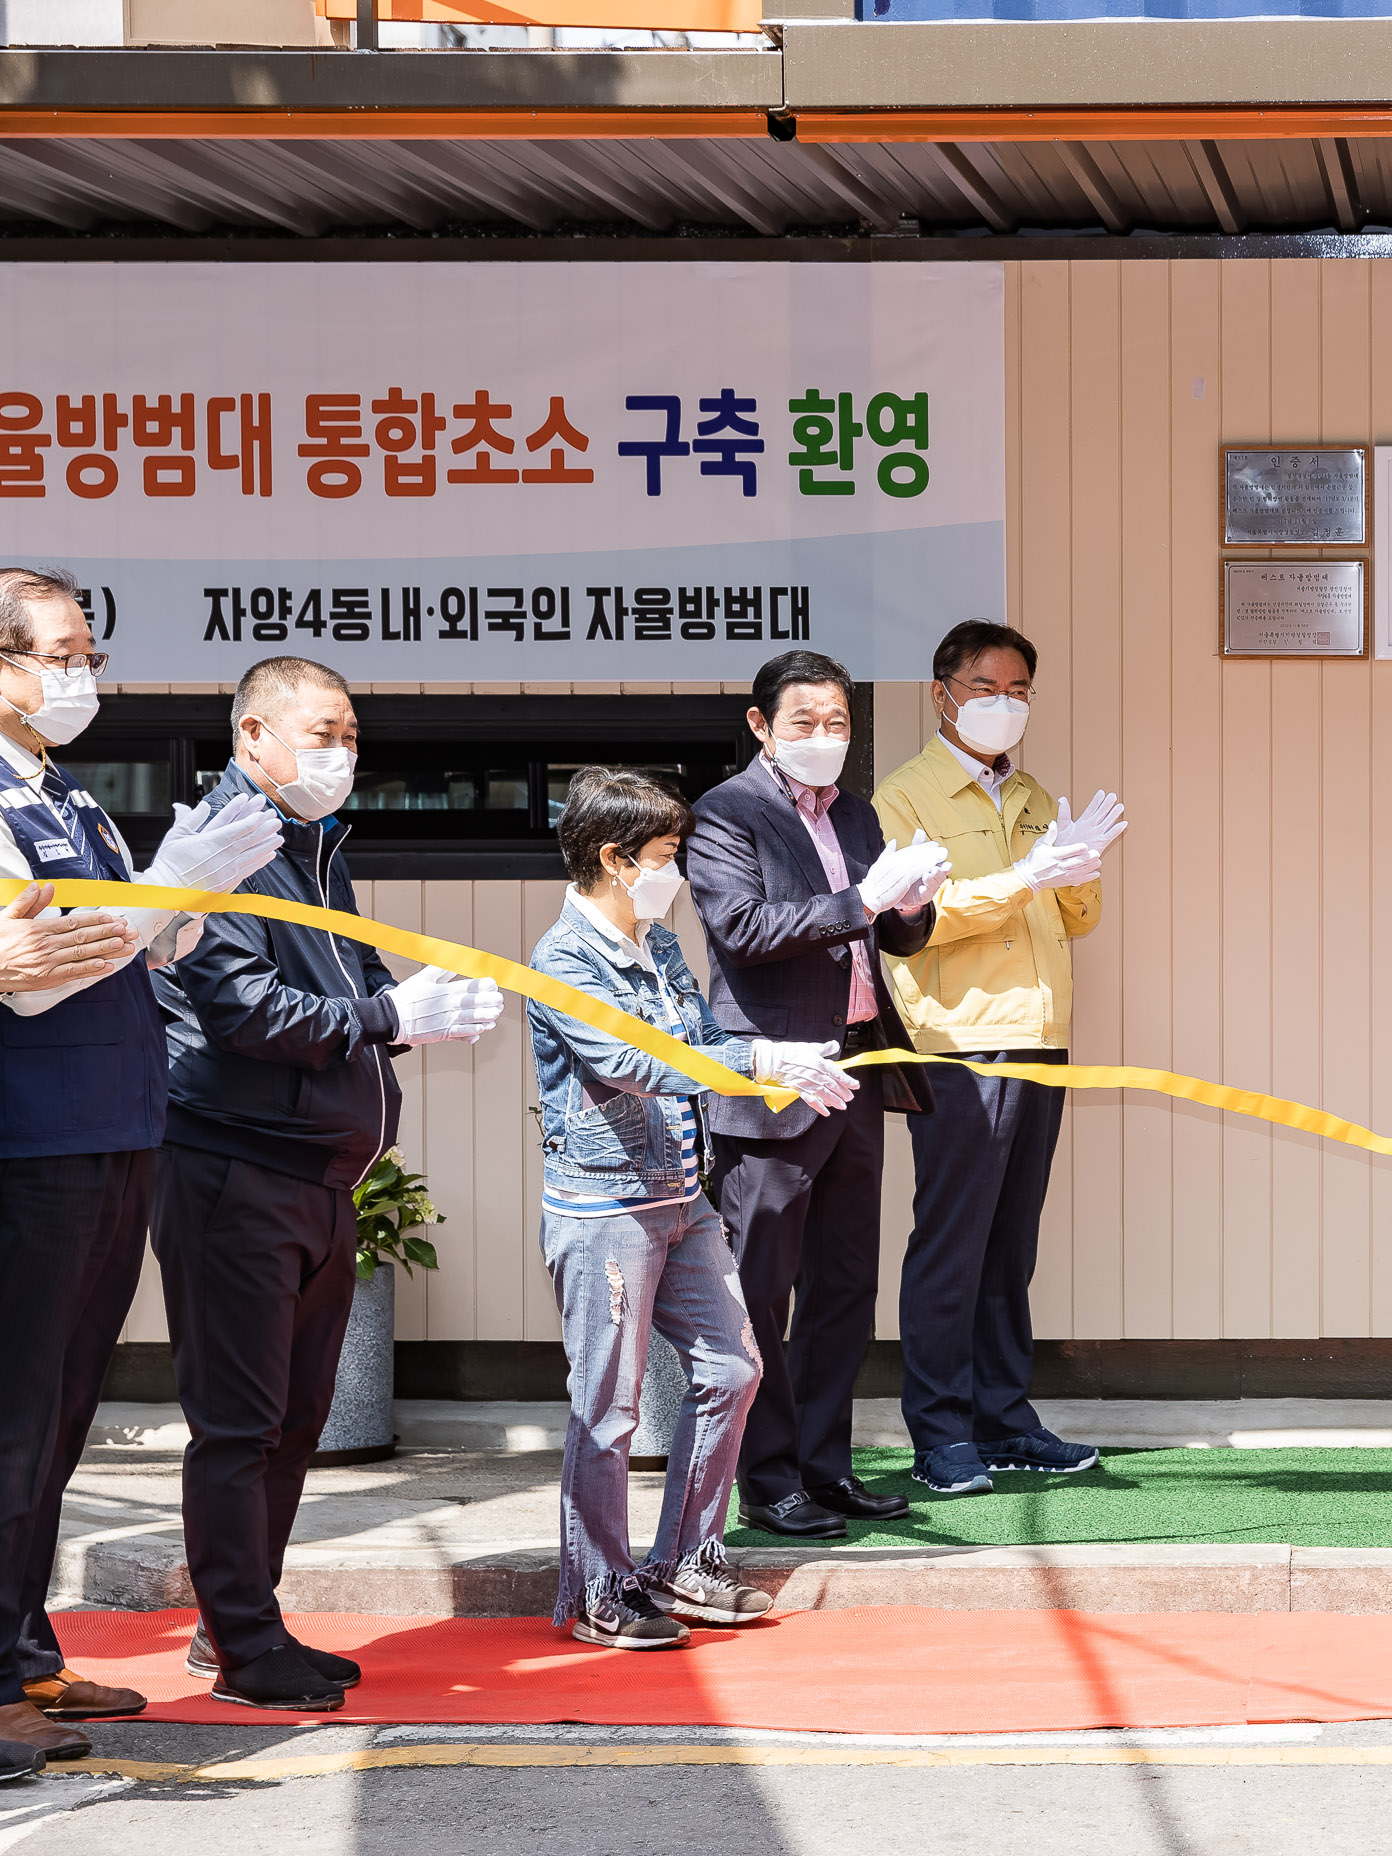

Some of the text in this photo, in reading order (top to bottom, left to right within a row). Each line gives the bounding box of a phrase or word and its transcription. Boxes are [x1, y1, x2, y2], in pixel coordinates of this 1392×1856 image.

[0, 387, 929, 499] 율방범대 통합초소 구축 환영
[1260, 573, 1329, 582] 베스트 자율방범대
[586, 587, 811, 641] 자율방범대
